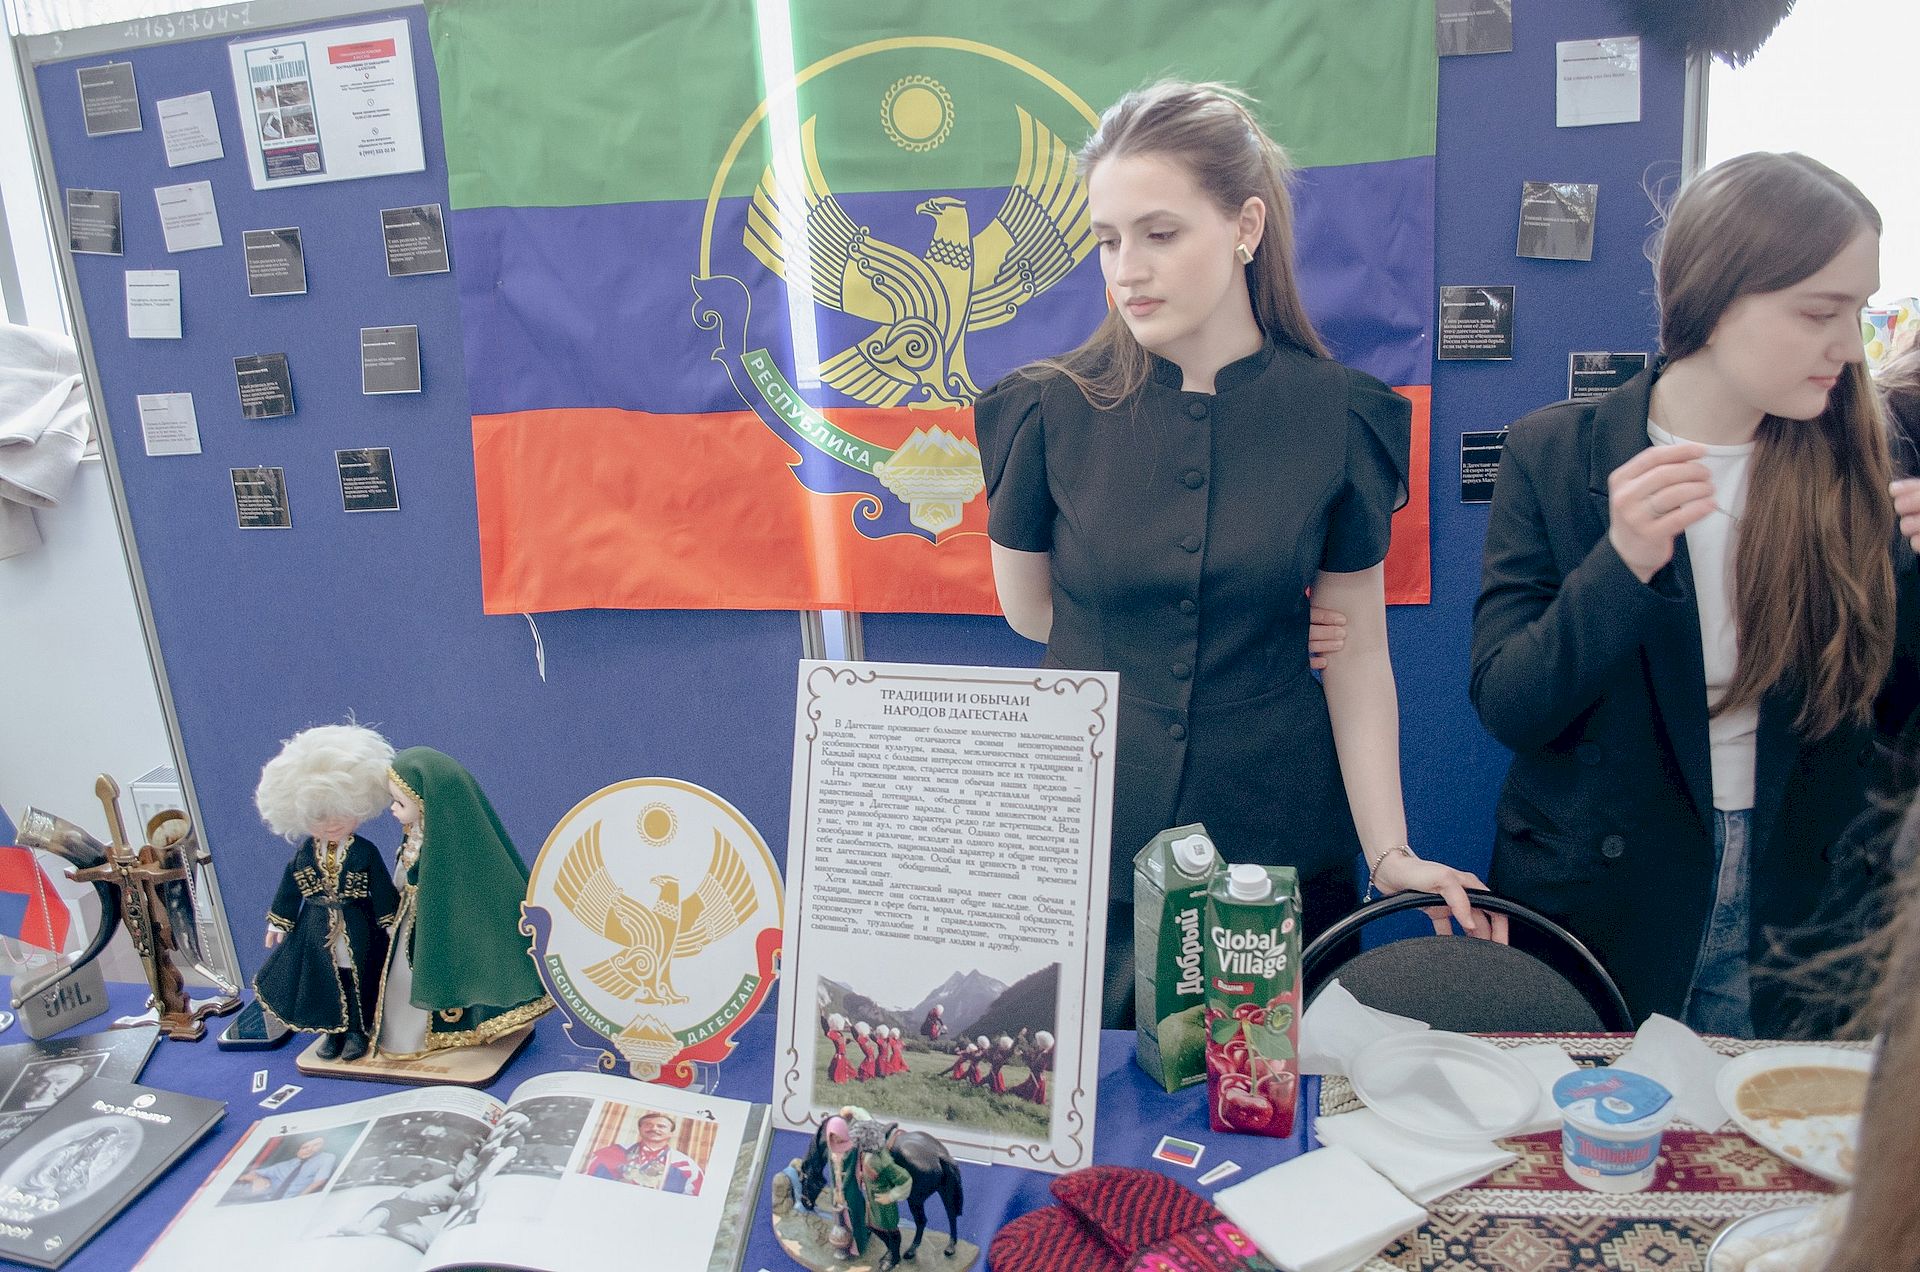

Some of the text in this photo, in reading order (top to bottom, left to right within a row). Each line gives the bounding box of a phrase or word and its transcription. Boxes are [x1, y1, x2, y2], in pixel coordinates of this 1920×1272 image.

[275, 60, 306, 83] ДАГЕСТАНУ
[750, 356, 871, 467] РЕСПУБЛИКА
[879, 689, 1030, 707] ТРАДИЦИИ И ОБЫЧАИ
[883, 705, 1028, 722] НАРОДОВ ДАГЕСТАНА
[844, 719, 884, 730] Дагестане
[887, 725, 930, 733] проживает
[933, 726, 967, 735] большое
[971, 730, 1017, 738] количество
[1020, 733, 1084, 742] малочисленных
[821, 740, 879, 749] особенностями
[963, 749, 1029, 759] межличностных
[869, 734, 902, 742] которые
[914, 736, 961, 744] отличаются
[1017, 743, 1084, 755] неповторимыми
[820, 758, 854, 767] обычаям
[920, 766, 958, 774] старается
[961, 769, 994, 777] познать
[821, 747, 855, 757] Каждый
[891, 753, 928, 762] большим
[931, 758, 972, 766] интересом
[975, 760, 1017, 768] относится
[1029, 763, 1074, 773] традициям
[849, 772, 897, 780] протяжении
[964, 777, 995, 787] обычаи
[1033, 784, 1067, 792] предков
[819, 789, 875, 801] нравственный
[934, 795, 976, 805] объединяя
[1000, 802, 1057, 813] консолидируя
[974, 790, 1030, 799] представляли
[1039, 794, 1081, 803] огромный
[818, 798, 854, 807] живущие
[868, 799, 909, 811] Дагестане
[995, 812, 1046, 821] множеством
[1052, 816, 1080, 824] адатов
[847, 810, 909, 820] разнообразного
[912, 815, 952, 825] характера
[955, 819, 979, 829] редко
[816, 827, 864, 836] своеобразие
[1028, 845, 1069, 855] воплощая
[967, 826, 1000, 837] Однако
[1026, 834, 1065, 844] несмотря
[836, 848, 887, 858] дагестанских
[930, 853, 961, 864] Особая
[979, 861, 1017, 869] ценность
[897, 844, 955, 855] национальный
[959, 849, 995, 859] характер
[1007, 851, 1034, 862] общие
[1038, 856, 1078, 865] интересы
[814, 865, 867, 875] многовековой
[845, 859, 882, 867] заключен
[968, 870, 1020, 880] испытанный
[1037, 876, 1077, 885] временем
[852, 879, 883, 887] каждый
[889, 882, 942, 892] дагестанский
[947, 888, 972, 896] народ
[1032, 894, 1064, 905] обычаи
[857, 889, 884, 897] вместе
[909, 894, 955, 904] составляют
[960, 898, 986, 908] общее
[812, 895, 871, 905] сохранившиеся
[881, 901, 904, 910] сфере
[967, 910, 1020, 920] гражданской
[812, 904, 863, 915] проповедуют
[874, 911, 912, 919] честность
[1019, 925, 1056, 936] простоту
[810, 923, 849, 932] сыновний
[874, 930, 910, 939] оказание
[913, 934, 946, 944] помощи
[949, 938, 976, 946] людям
[866, 920, 914, 930] трудолюбие
[998, 934, 1059, 945] откровенность
[1211, 926, 1278, 950] Global
[1175, 908, 1204, 995] Добрый
[1216, 946, 1287, 979] Village
[43, 982, 91, 1018] JBL
[547, 957, 756, 1046] РЕСПУБЛИКА ДАГЕСТАН
